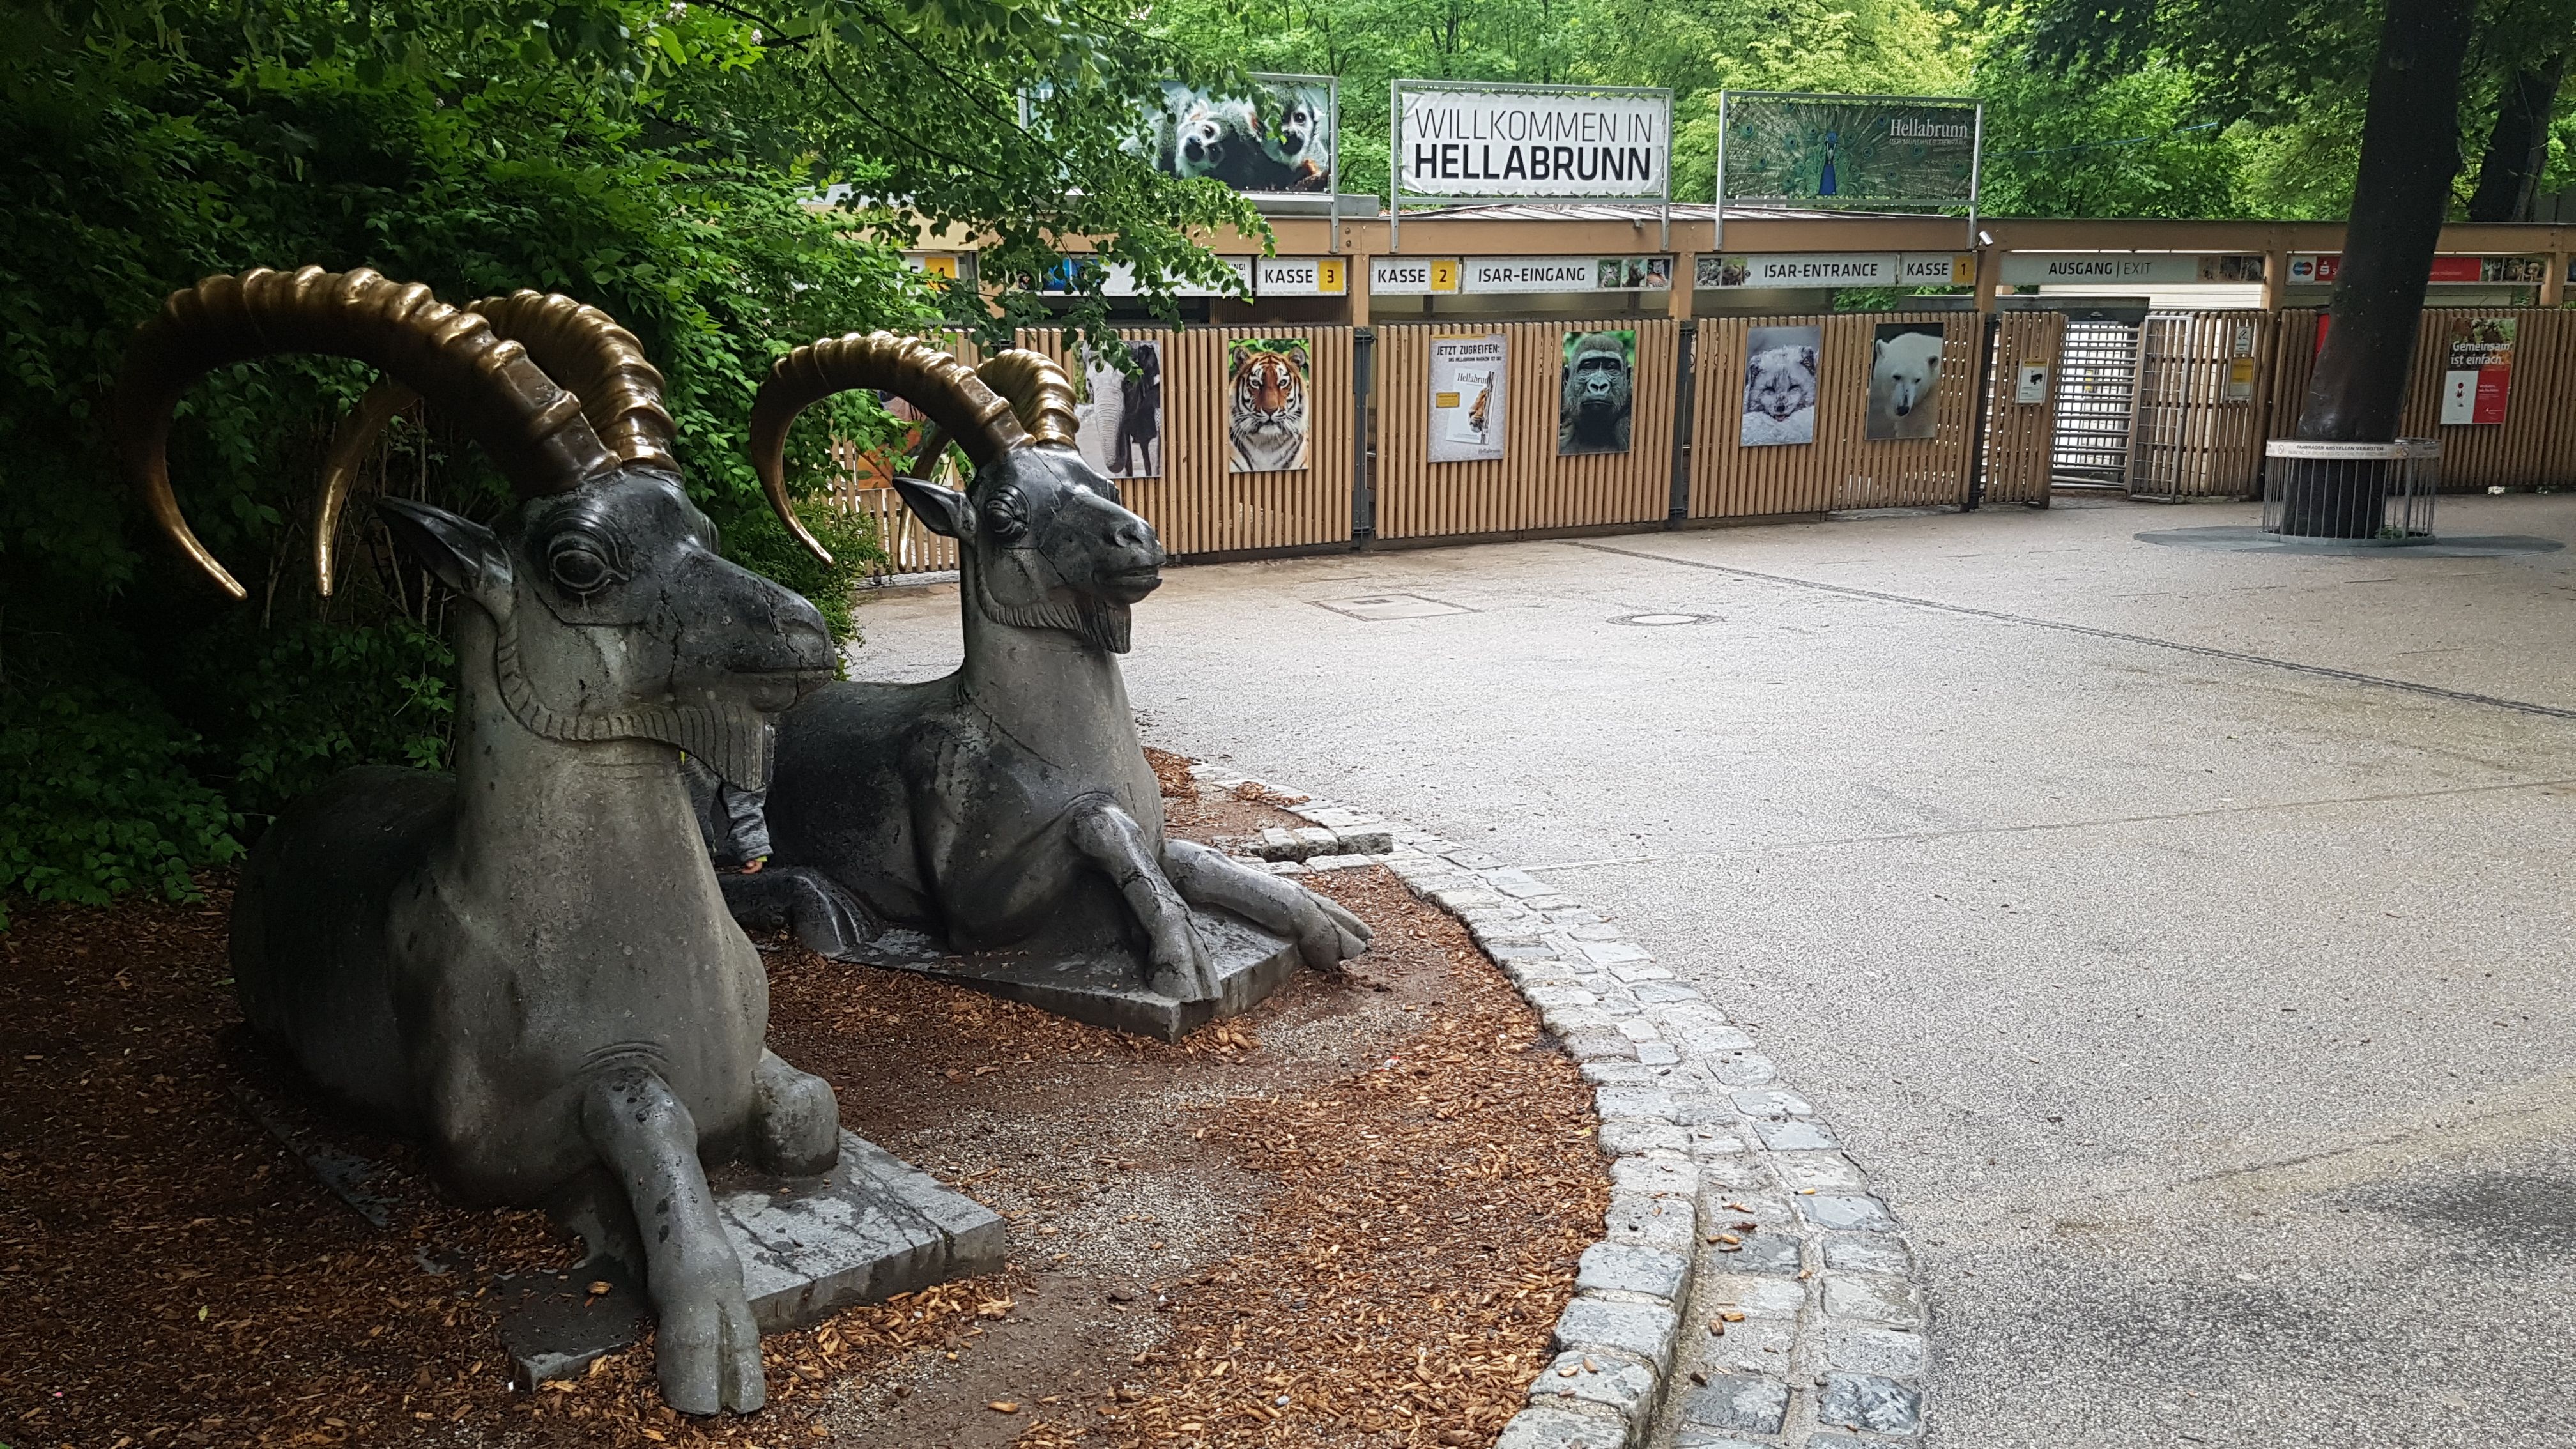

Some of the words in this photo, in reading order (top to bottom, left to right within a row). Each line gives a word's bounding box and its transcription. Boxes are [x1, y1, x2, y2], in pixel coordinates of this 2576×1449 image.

[1415, 108, 1616, 142] WILLKOMMEN
[1627, 113, 1652, 142] IN
[1890, 118, 1968, 137] Hellabrunn
[1414, 143, 1650, 181] HELLABRUNN
[1478, 267, 1586, 282] ISAR-EINGANG
[1764, 263, 1878, 278] ISAR-ENTRANCE
[1906, 263, 1949, 276] KASSE
[1961, 263, 1966, 276] 1
[2049, 262, 2113, 275] AUSGANG
[2124, 262, 2152, 275] EXIT
[1265, 269, 1313, 283] KASSE
[1327, 270, 1334, 283] 3
[1377, 269, 1425, 283] KASSE
[1439, 269, 1447, 282] 2
[1437, 346, 1457, 356] JETZT
[1460, 344, 1501, 355] ZUGREIFEN:
[2453, 341, 2510, 351] Gemeinsam
[2451, 354, 2464, 365] ist
[2466, 354, 2504, 365] einfach.
